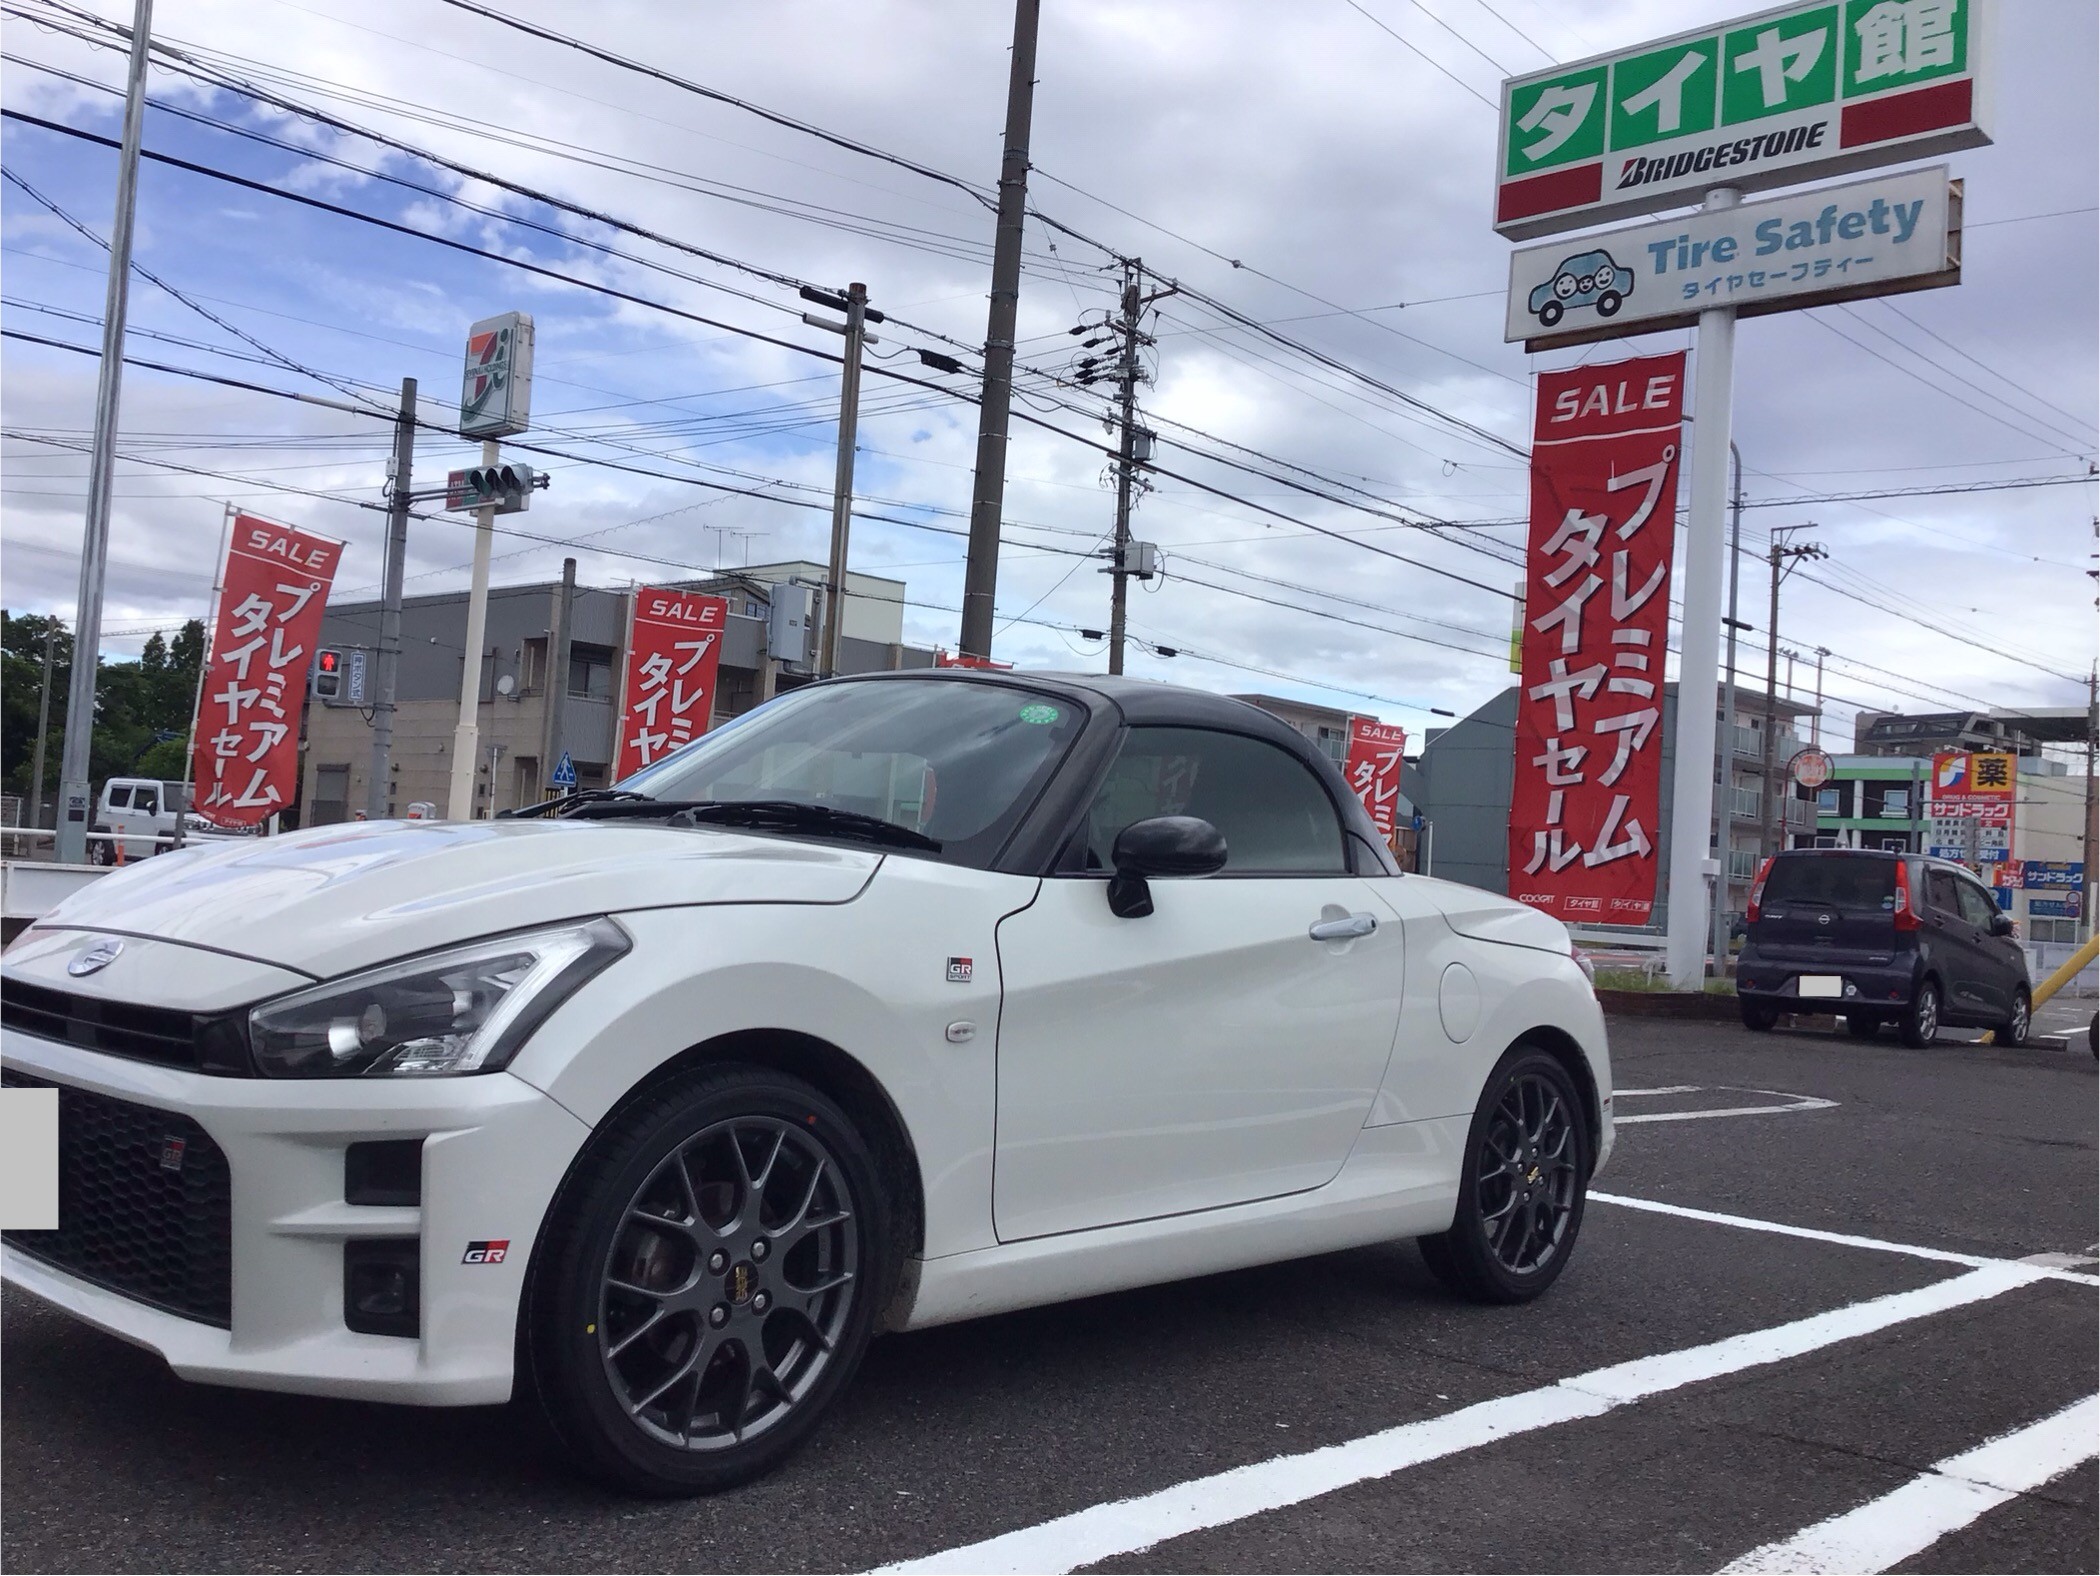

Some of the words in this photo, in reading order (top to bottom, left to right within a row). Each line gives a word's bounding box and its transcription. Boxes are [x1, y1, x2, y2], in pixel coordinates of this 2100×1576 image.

[1516, 0, 1956, 161] タイヤ館
[1615, 121, 1828, 190] BRIDGESTONE
[1648, 232, 1738, 275] Tire
[1755, 199, 1925, 258] Safety
[1683, 256, 1874, 300] タイヤセーフティー
[1550, 374, 1676, 424] SALE
[248, 530, 330, 570] SALE
[650, 599, 718, 623] SALE
[1583, 443, 1676, 868] プレミアム
[204, 592, 275, 808] タイヤセール
[233, 582, 322, 808] プレミアム
[629, 652, 673, 771] タイヤ
[1523, 508, 1608, 875] タイヤセール
[1361, 725, 1402, 740] SALE
[1978, 758, 2007, 787] 薬
[1934, 803, 2009, 817] サンドラッグ
[2028, 871, 2083, 883] サンドラッグ
[951, 964, 972, 974] GR
[465, 1249, 505, 1262] GR
